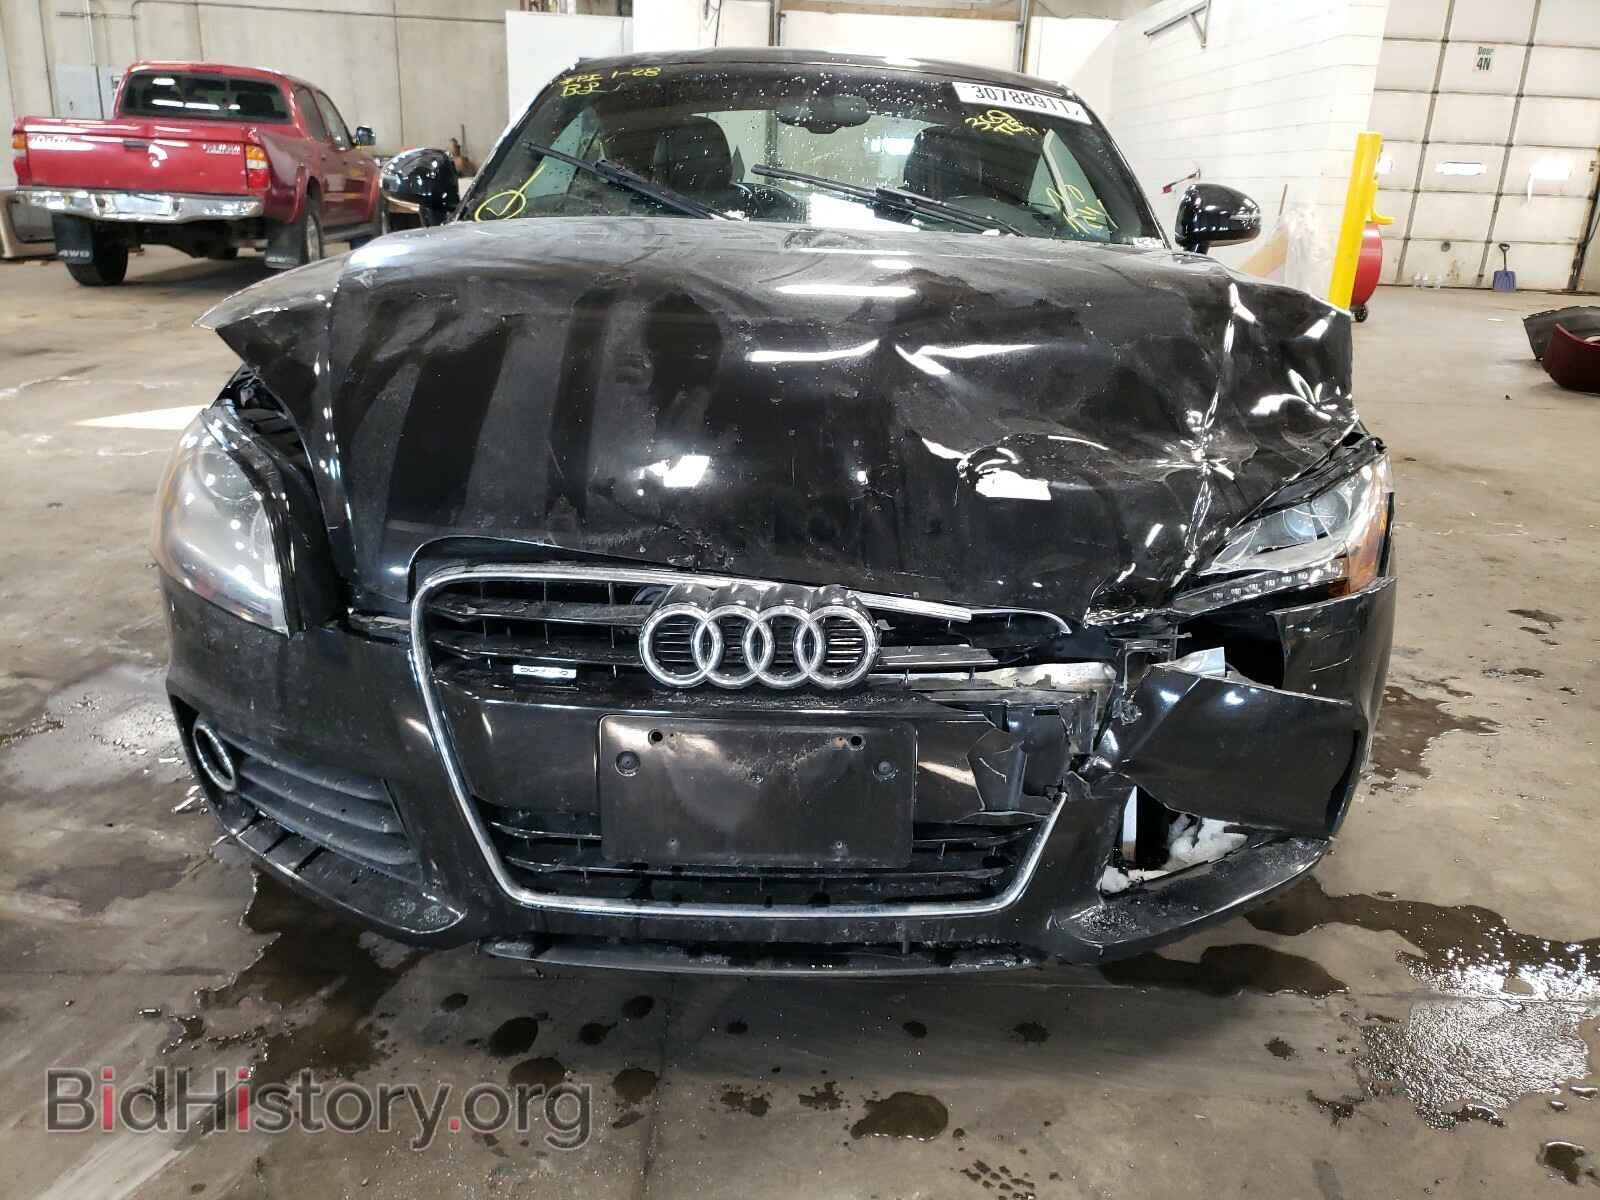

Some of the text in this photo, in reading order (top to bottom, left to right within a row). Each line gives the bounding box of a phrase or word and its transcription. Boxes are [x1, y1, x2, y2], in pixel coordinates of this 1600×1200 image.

[1477, 58, 1491, 70] 4N
[971, 85, 1071, 114] 30788911
[58, 249, 90, 257] 4WD
